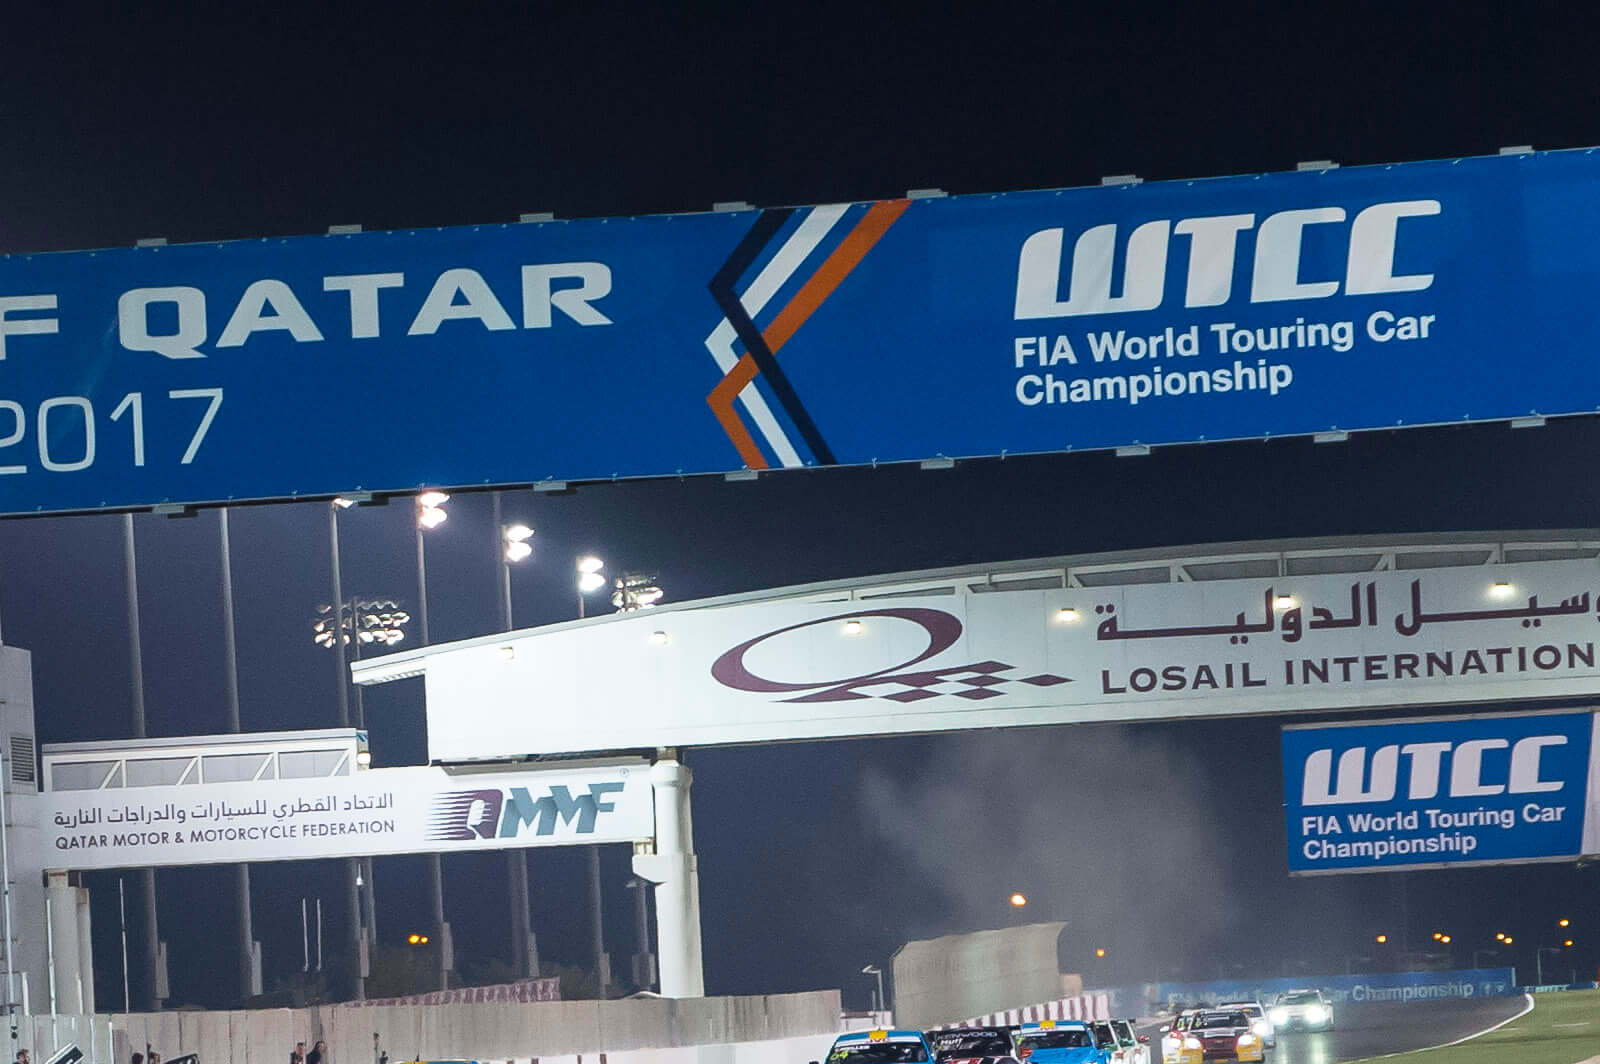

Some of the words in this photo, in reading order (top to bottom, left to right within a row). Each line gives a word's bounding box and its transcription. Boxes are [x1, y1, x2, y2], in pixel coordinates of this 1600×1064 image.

[1015, 200, 1440, 320] WTCC
[119, 262, 612, 359] QATAR
[1016, 336, 1076, 367] FIA
[1088, 326, 1198, 361] World
[1211, 318, 1353, 355] Touring
[1367, 311, 1435, 341] Car
[1016, 360, 1293, 405] Championship
[1096, 581, 1377, 643] الدولية
[1102, 663, 1267, 694] LOSAIL
[1286, 642, 1595, 685] INTERNATION
[1303, 736, 1568, 806] WTCC
[107, 804, 186, 825] والدراجات
[191, 800, 267, 822] للسيارات
[272, 796, 337, 819] القطري
[343, 793, 393, 811] الاتحاد
[53, 807, 102, 829] النارية
[1302, 815, 1342, 836] FIA
[1347, 811, 1418, 833] World
[1425, 807, 1515, 830] Touring
[1522, 803, 1566, 823] Car
[55, 834, 108, 850] QATAR
[112, 831, 169, 847] MOTOR
[174, 831, 185, 844] &
[190, 826, 297, 843] MOTORCYCLE
[303, 820, 394, 837] FEDERATION
[1303, 832, 1477, 861] Championship
[1353, 981, 1475, 1001] Championship
